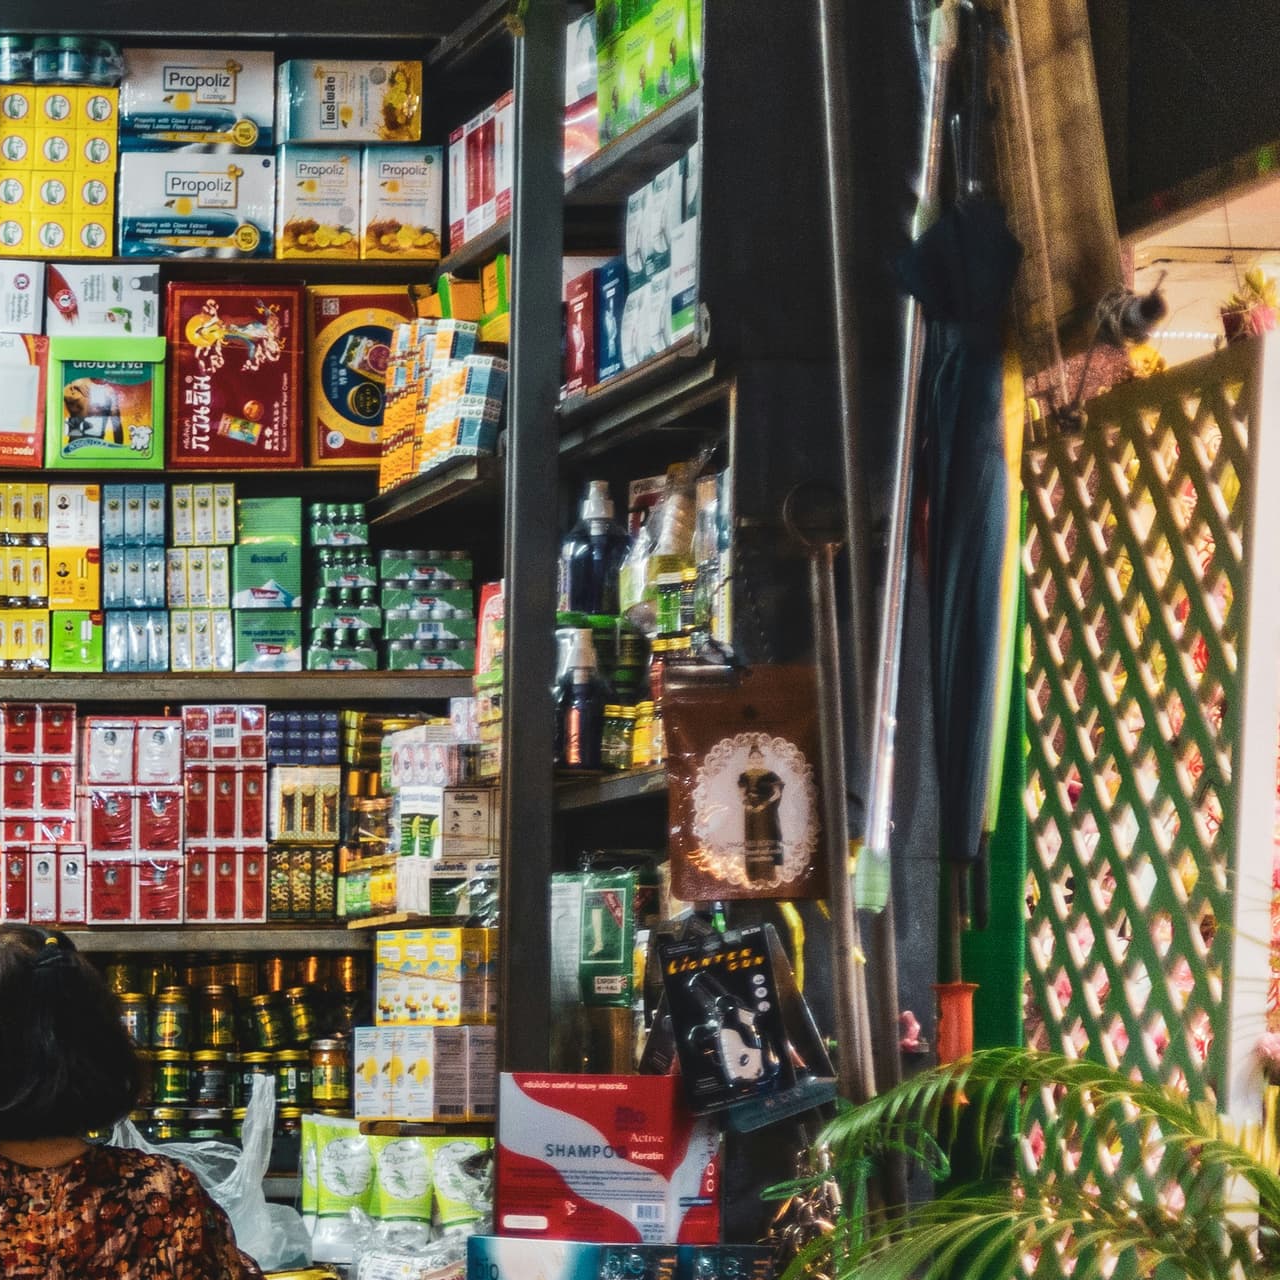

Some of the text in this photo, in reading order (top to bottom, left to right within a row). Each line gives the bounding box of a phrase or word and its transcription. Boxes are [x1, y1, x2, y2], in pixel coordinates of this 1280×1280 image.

[169, 72, 231, 92] Propoliz
[299, 163, 345, 176] Propoliz
[382, 163, 428, 177] Propoliz
[171, 177, 233, 196] Propoliz
[630, 1133, 664, 1145] Active
[545, 1143, 627, 1159] SHAMPOO
[631, 1151, 664, 1163] Keratin
